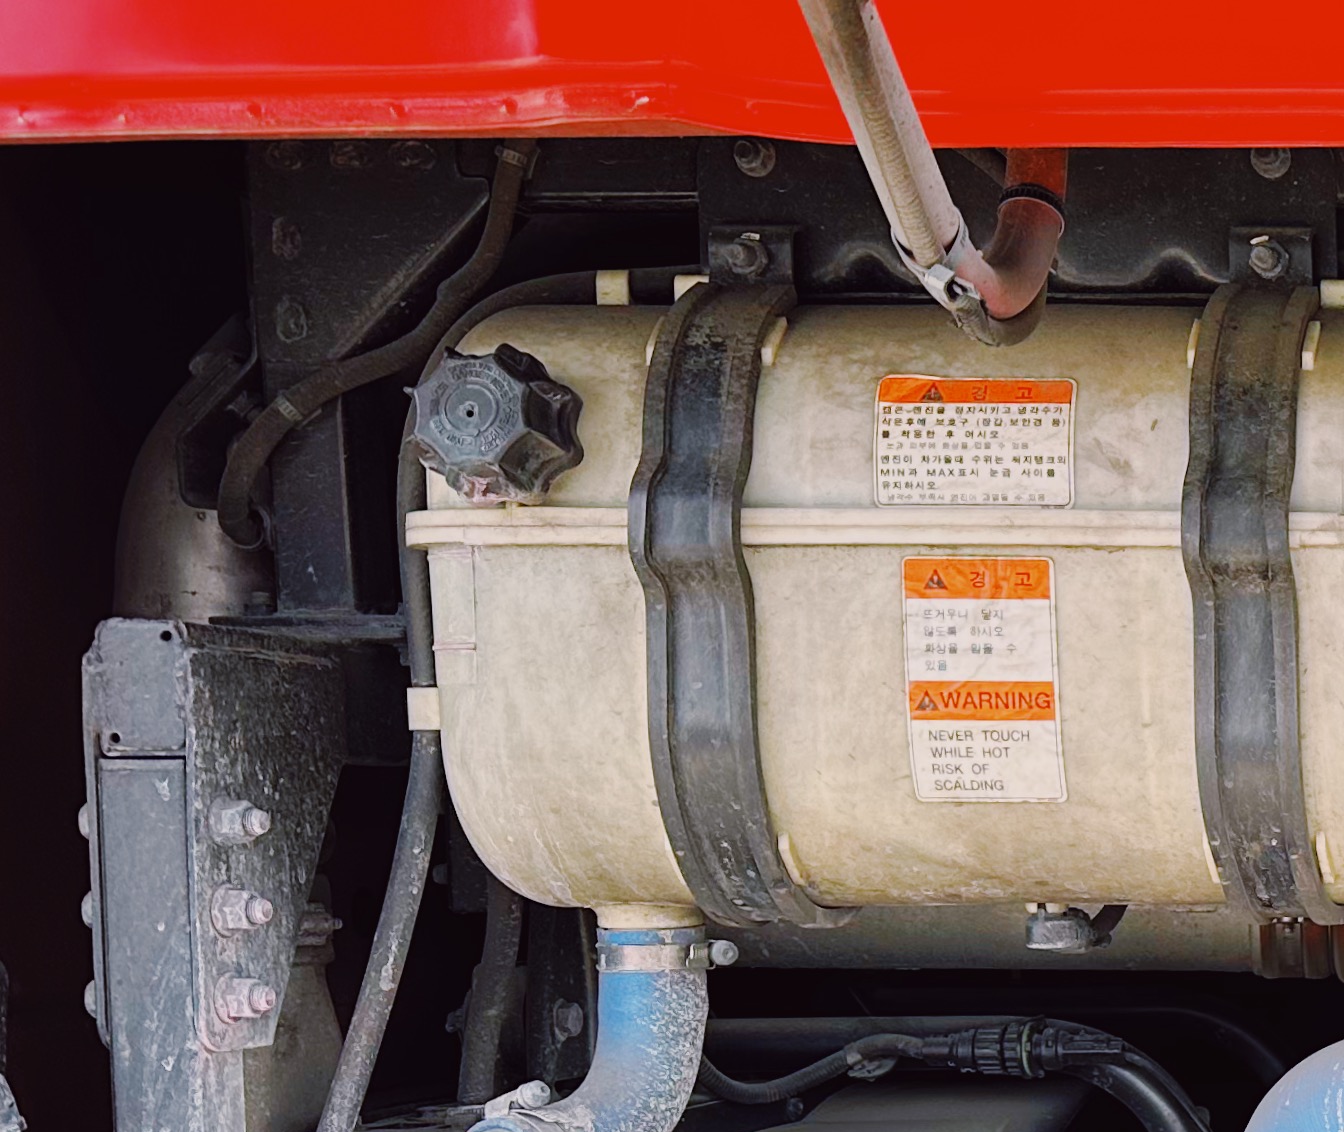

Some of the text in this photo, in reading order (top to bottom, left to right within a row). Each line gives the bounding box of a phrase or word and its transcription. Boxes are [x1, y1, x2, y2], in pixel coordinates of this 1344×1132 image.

[880, 454, 913, 465] 엔진이
[970, 571, 1032, 588] 경 고
[923, 609, 968, 620] 뜨거우니
[923, 626, 1004, 637] 않도록 하시오
[1006, 643, 1017, 655] 수
[939, 691, 1051, 710] WARNING
[928, 729, 1030, 742] NEVER TOUCH
[930, 746, 1011, 759] WHILE HOT
[931, 763, 990, 775] RISK OF
[934, 779, 1005, 792] SCALDING
